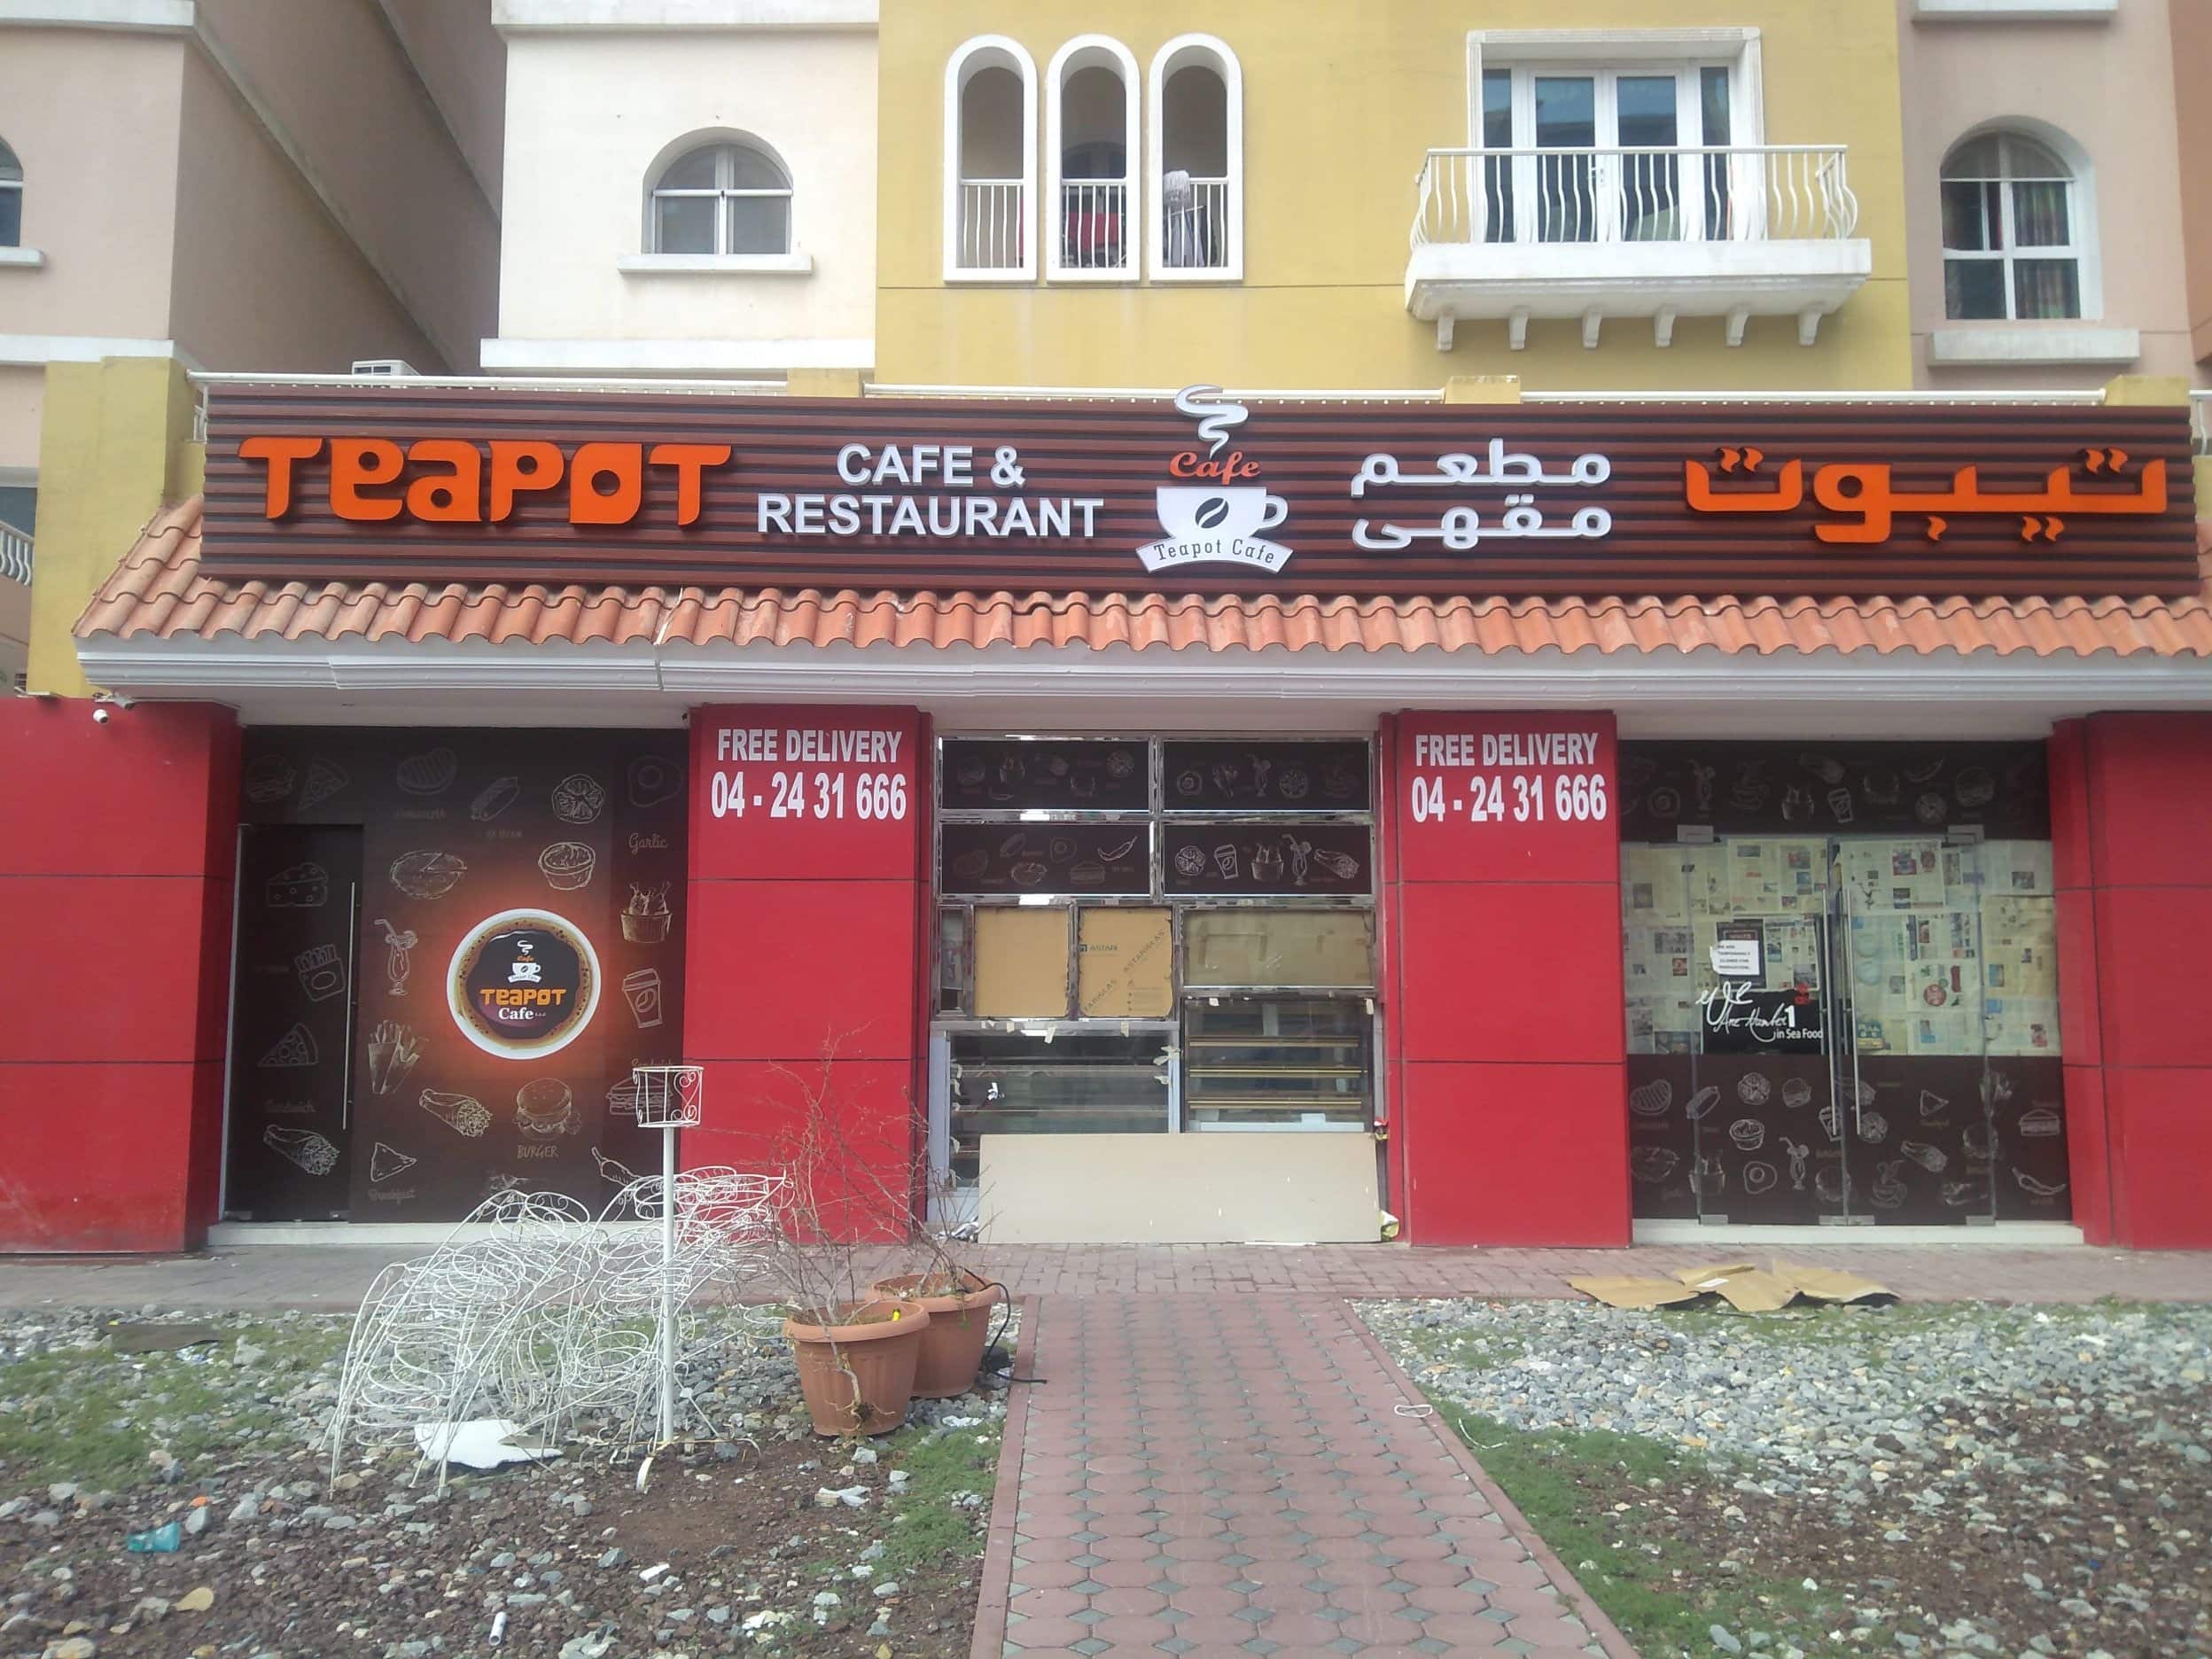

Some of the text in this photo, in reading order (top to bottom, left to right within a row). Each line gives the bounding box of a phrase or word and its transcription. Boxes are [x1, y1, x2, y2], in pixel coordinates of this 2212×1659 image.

[837, 442, 1026, 488] CAFE &
[1168, 452, 1262, 485] Cafe
[1351, 438, 1611, 498] مطعم
[757, 493, 1104, 538] RESTAURANT
[1351, 495, 1612, 550] مقهى
[1154, 539, 1274, 564] Teapot Cafe
[718, 728, 902, 762] FREE DELIVERY
[1415, 732, 1599, 767] FREE DELIVERY
[712, 771, 744, 818] 04
[770, 771, 805, 818] 24
[814, 772, 844, 819] 31
[856, 773, 907, 820] 666
[1412, 775, 1445, 822] 04
[1470, 775, 1505, 822] 24
[1513, 775, 1544, 822] 31
[1555, 774, 1607, 822] 666
[628, 832, 668, 855] Garlic
[498, 1007, 534, 1020] Cafe
[1694, 981, 1753, 1026] We
[1713, 1002, 1796, 1042] Are Number 1
[1777, 1028, 1823, 1039] in Sea Food
[517, 1144, 559, 1159] BURGER
